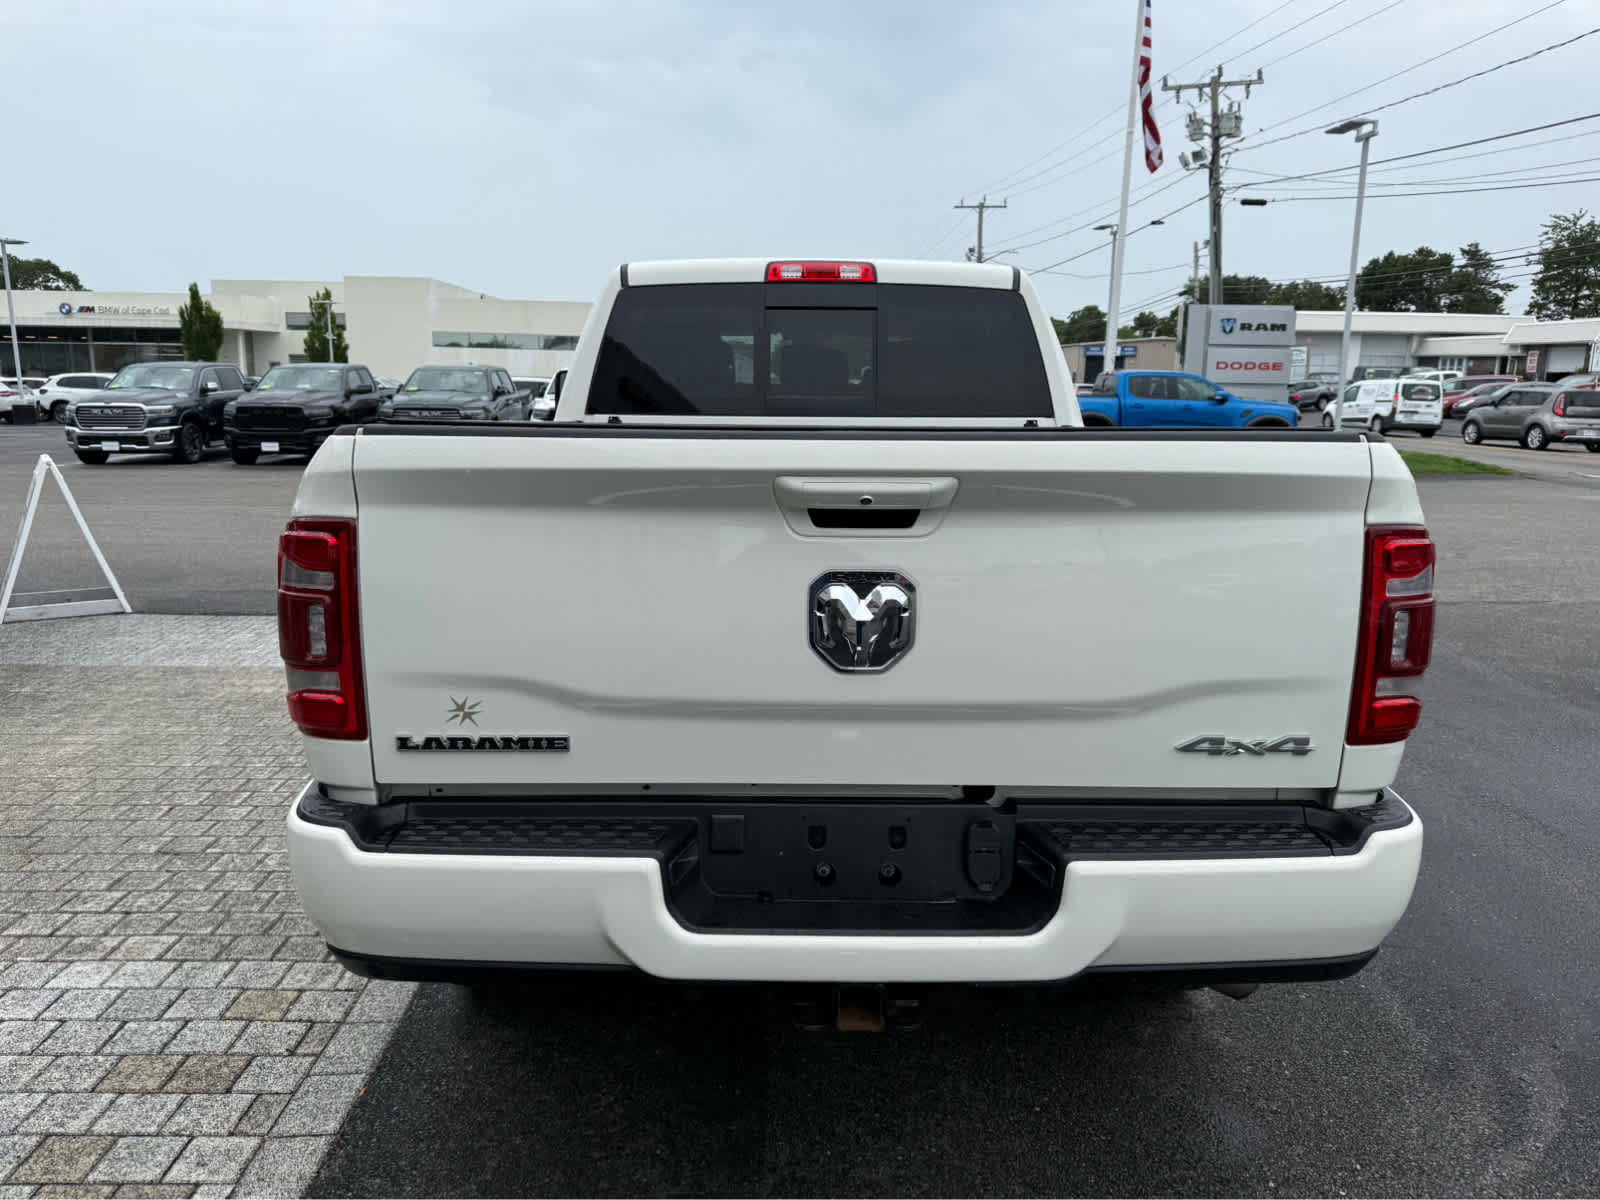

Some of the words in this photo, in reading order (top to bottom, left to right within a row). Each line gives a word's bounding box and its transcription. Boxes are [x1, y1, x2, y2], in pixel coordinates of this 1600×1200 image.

[98, 305, 120, 314] BMW
[1240, 323, 1288, 332] RAM
[1215, 361, 1284, 371] DODGE
[396, 735, 570, 752] LARAMIE
